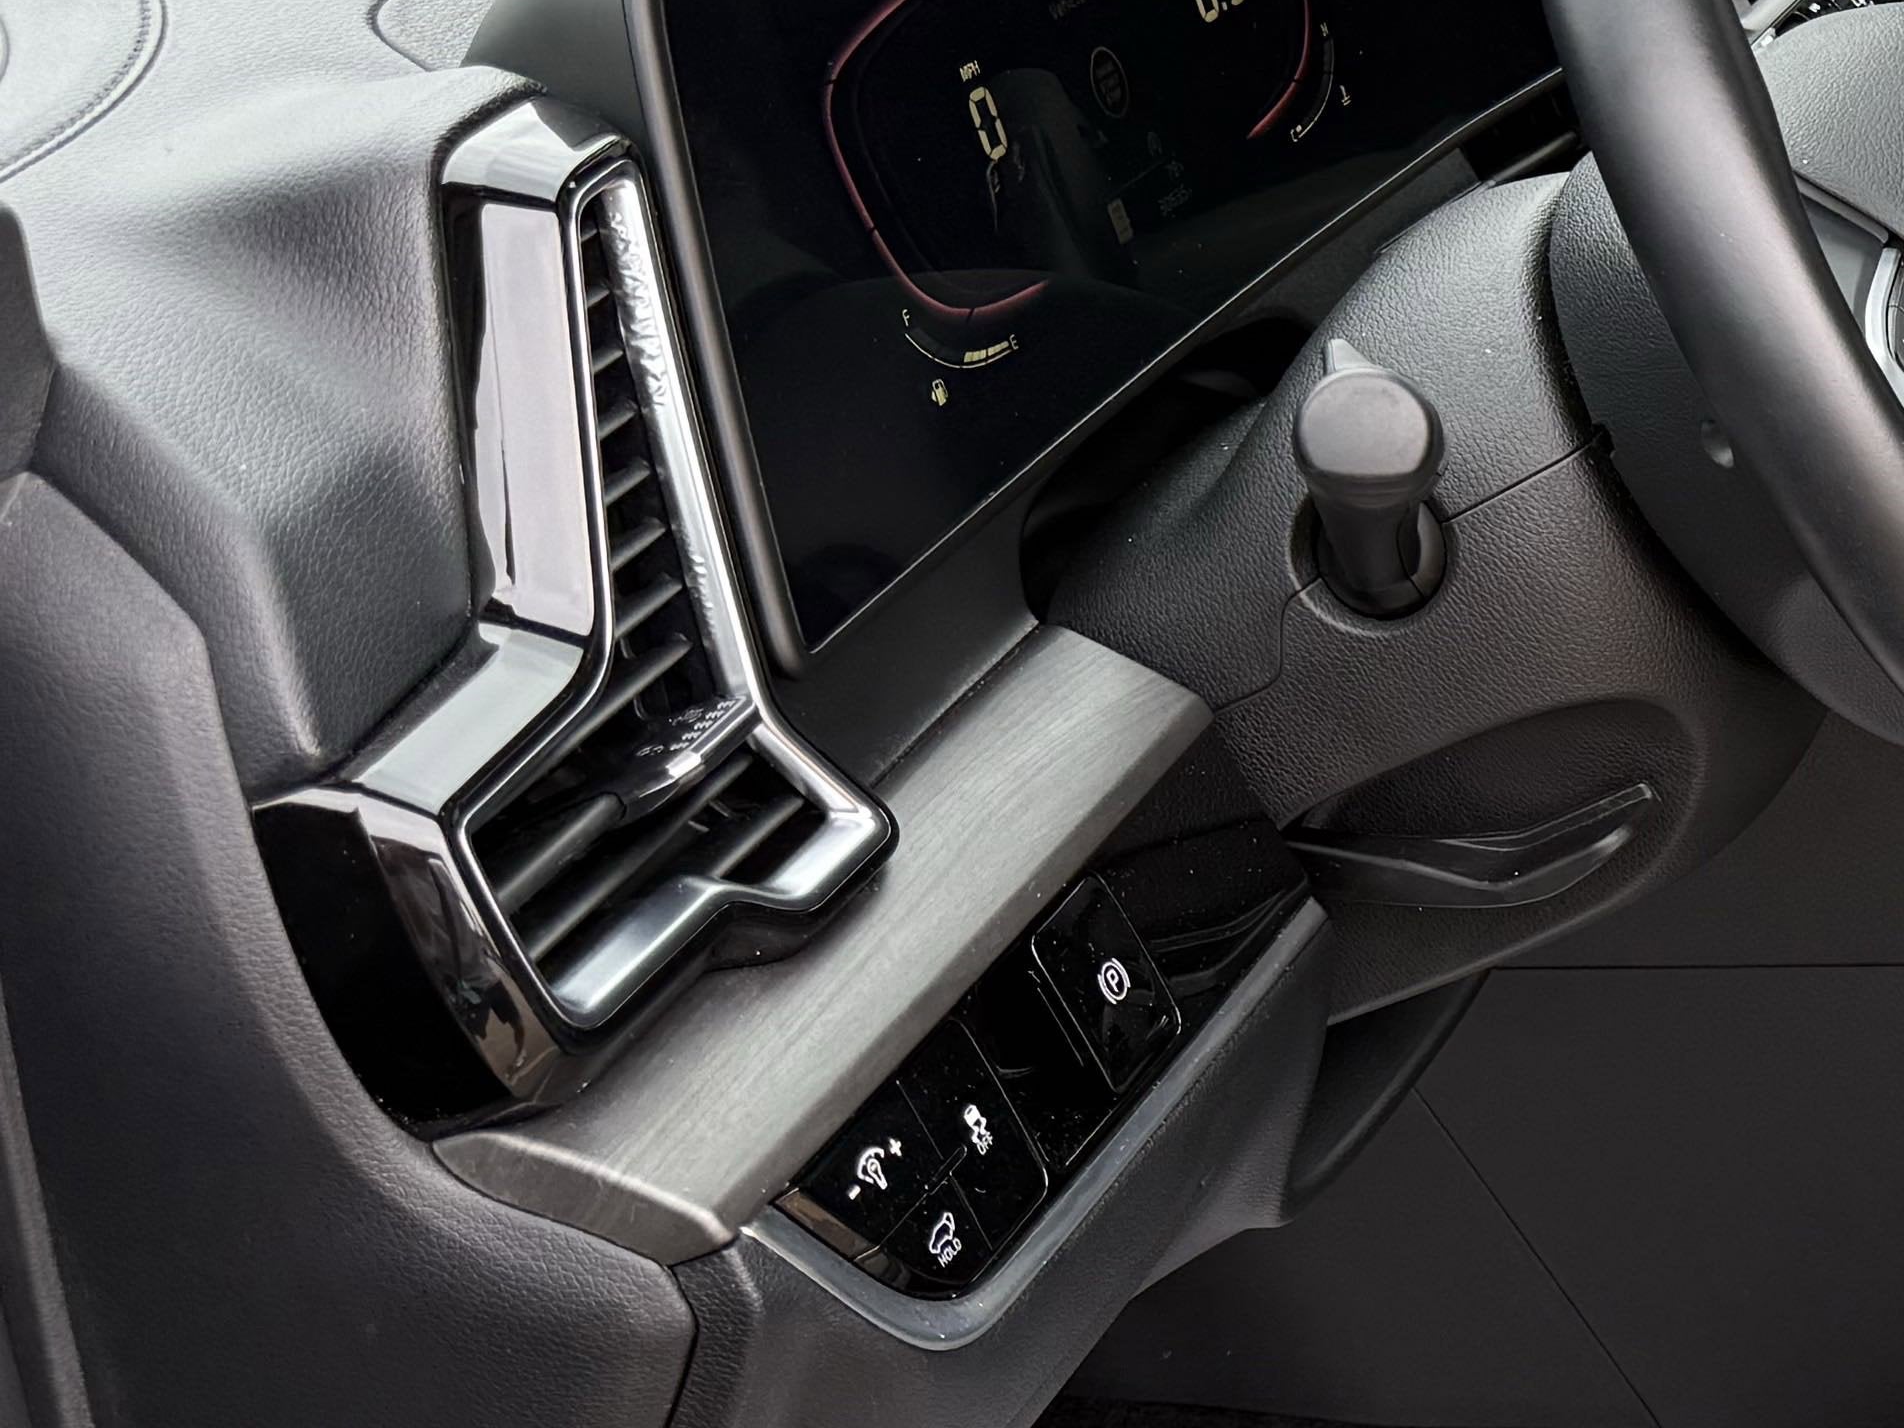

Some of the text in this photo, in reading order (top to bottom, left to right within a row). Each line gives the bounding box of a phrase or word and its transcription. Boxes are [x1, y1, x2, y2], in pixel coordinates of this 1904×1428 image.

[959, 59, 982, 83] MPH
[967, 84, 1009, 163] 0
[900, 305, 912, 329] F
[1005, 331, 1019, 353] E
[976, 1133, 994, 1155] OFF
[937, 1238, 963, 1269] HOLD
